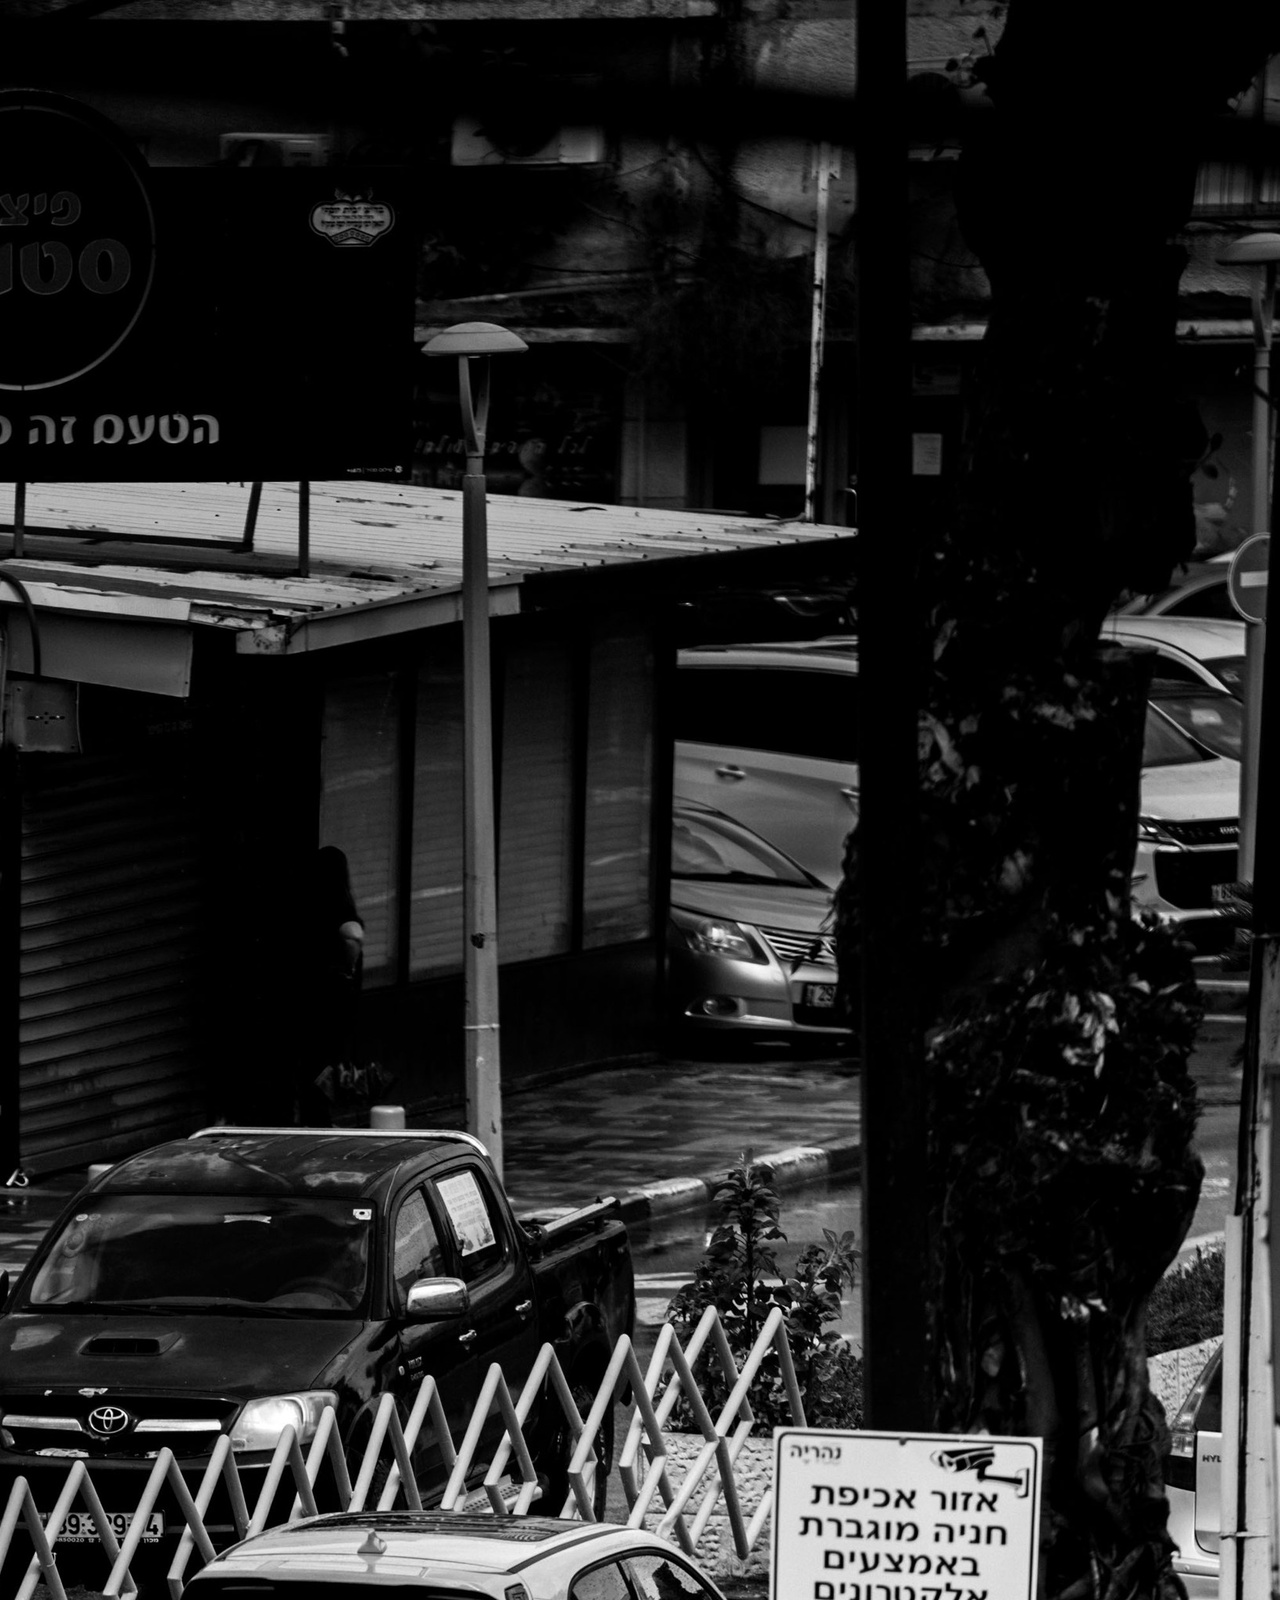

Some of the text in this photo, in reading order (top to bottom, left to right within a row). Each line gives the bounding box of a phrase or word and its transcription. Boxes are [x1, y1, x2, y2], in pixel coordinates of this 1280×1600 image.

[28, 415, 77, 445] זה
[93, 413, 220, 446] הטעם
[811, 1485, 998, 1512] אזור אכיפת
[799, 1516, 1007, 1545] חניה מוגברת
[823, 1550, 980, 1577] באמצעים
